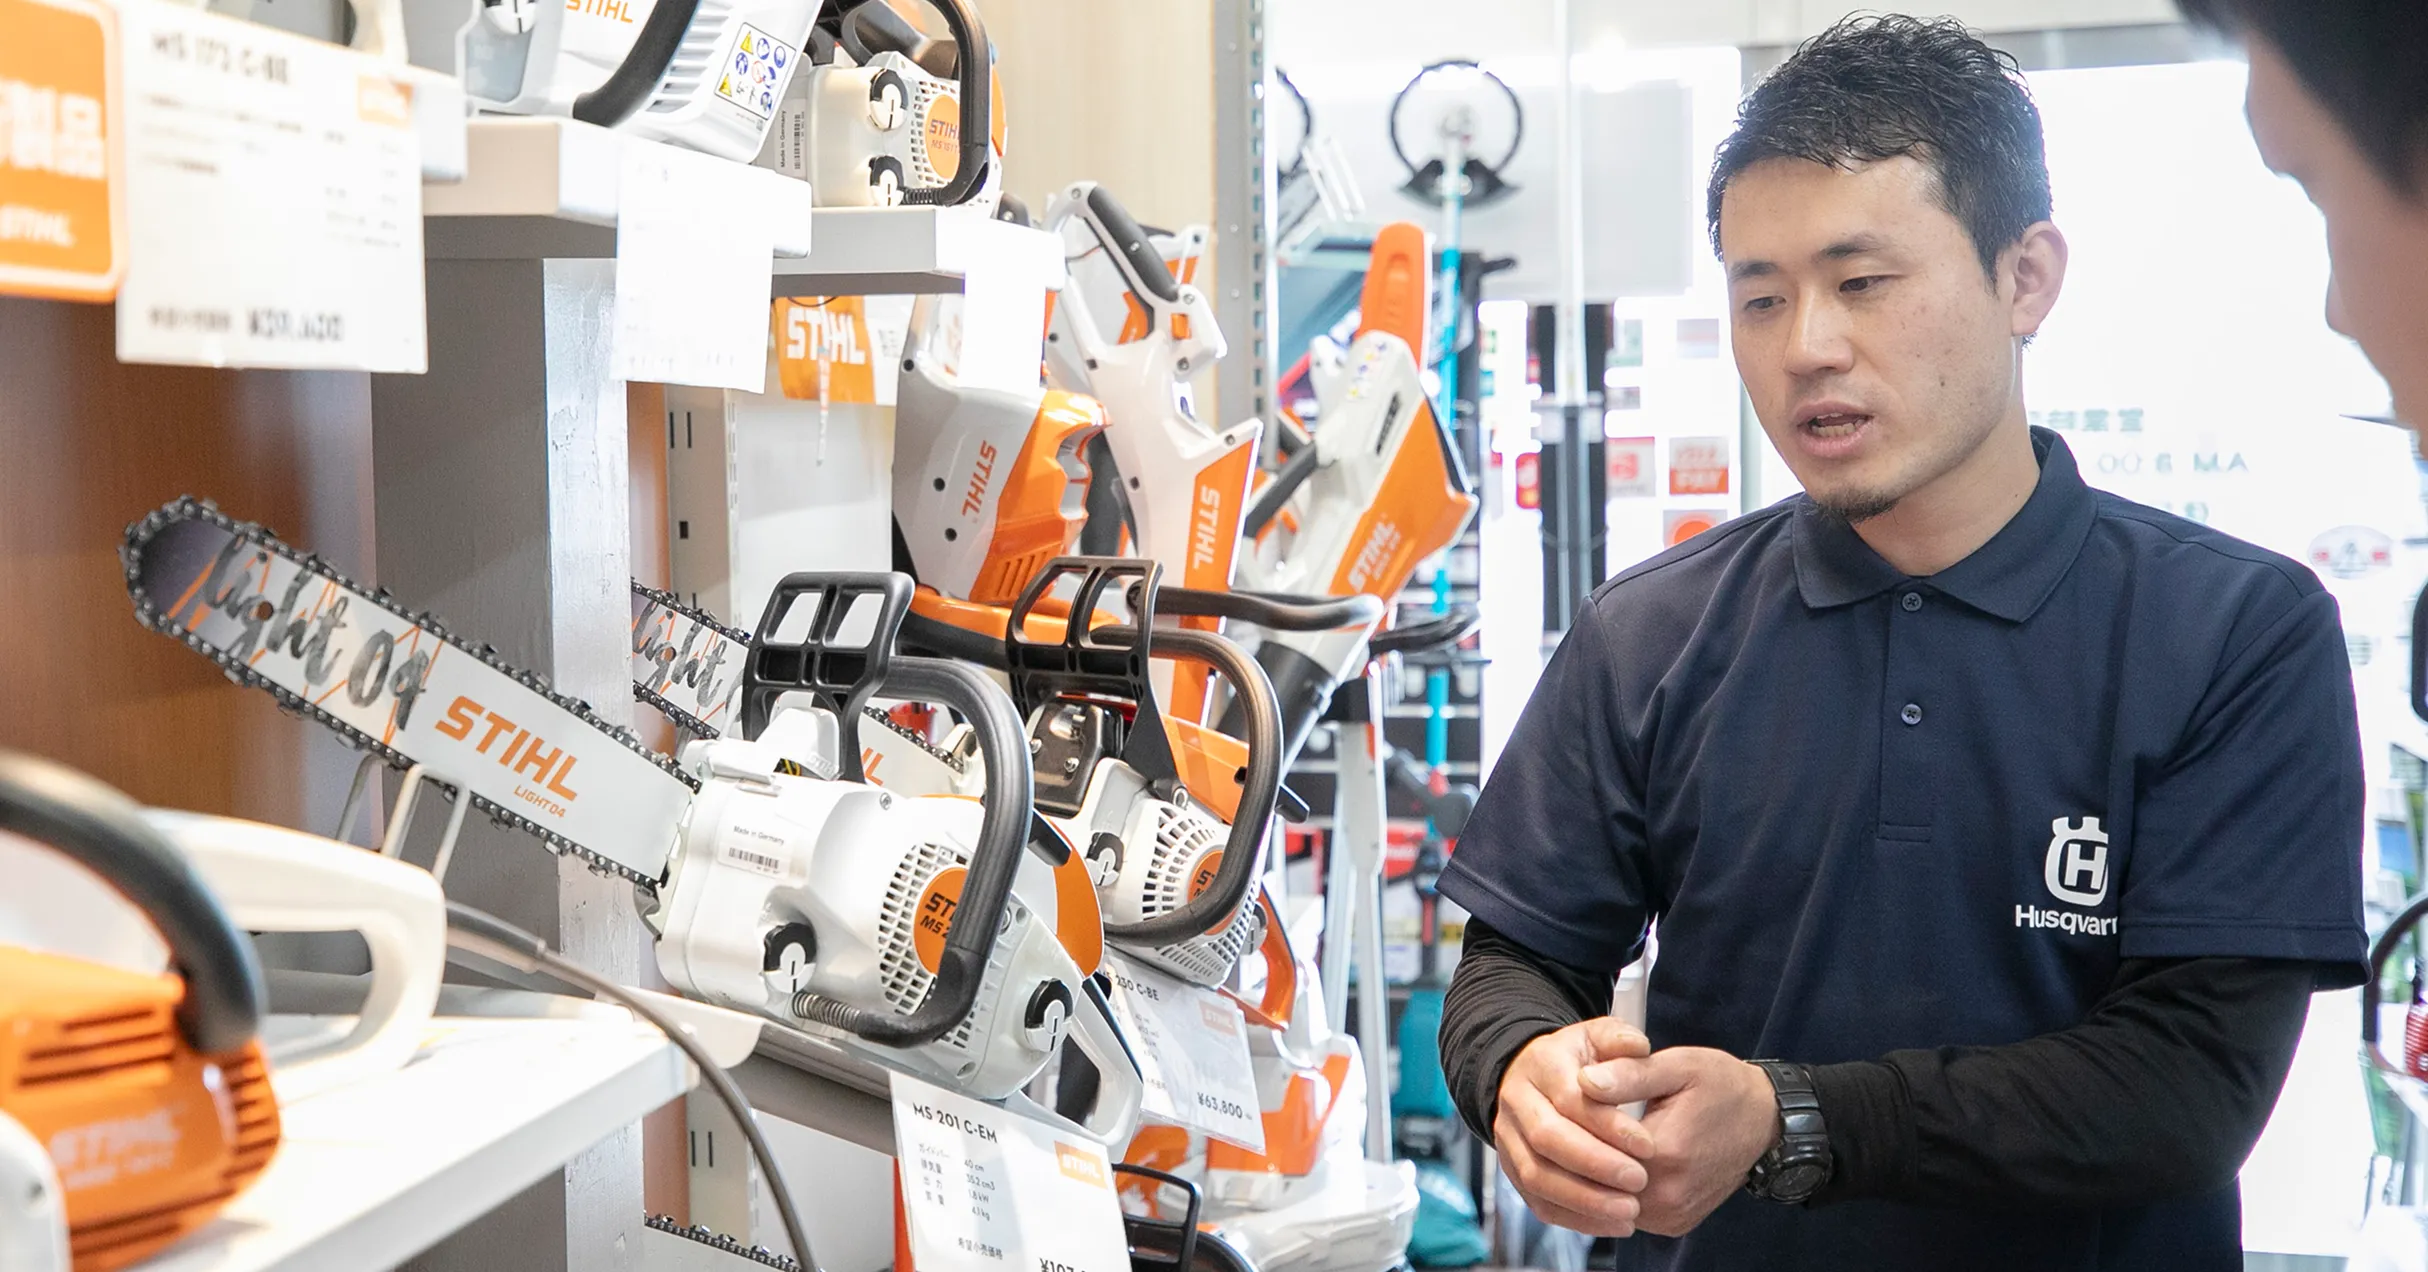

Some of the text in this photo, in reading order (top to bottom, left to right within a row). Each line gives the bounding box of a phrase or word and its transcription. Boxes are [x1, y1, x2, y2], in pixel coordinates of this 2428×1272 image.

[779, 110, 787, 141] Germany
[929, 119, 958, 139] STIH
[779, 150, 787, 168] Made
[786, 307, 866, 365] STIHL
[962, 440, 998, 517] STIHL
[1192, 485, 1221, 571] STIHL
[436, 696, 578, 802] STIHL
[514, 785, 550, 809] LIGHT
[920, 915, 944, 934] MS
[1115, 975, 1134, 991] 230
[1137, 983, 1160, 1001] C-BE
[1197, 1091, 1243, 1119] ¥63,800
[913, 1102, 998, 1144] MS 201 C-EM
[1061, 1153, 1101, 1179] STIHL
